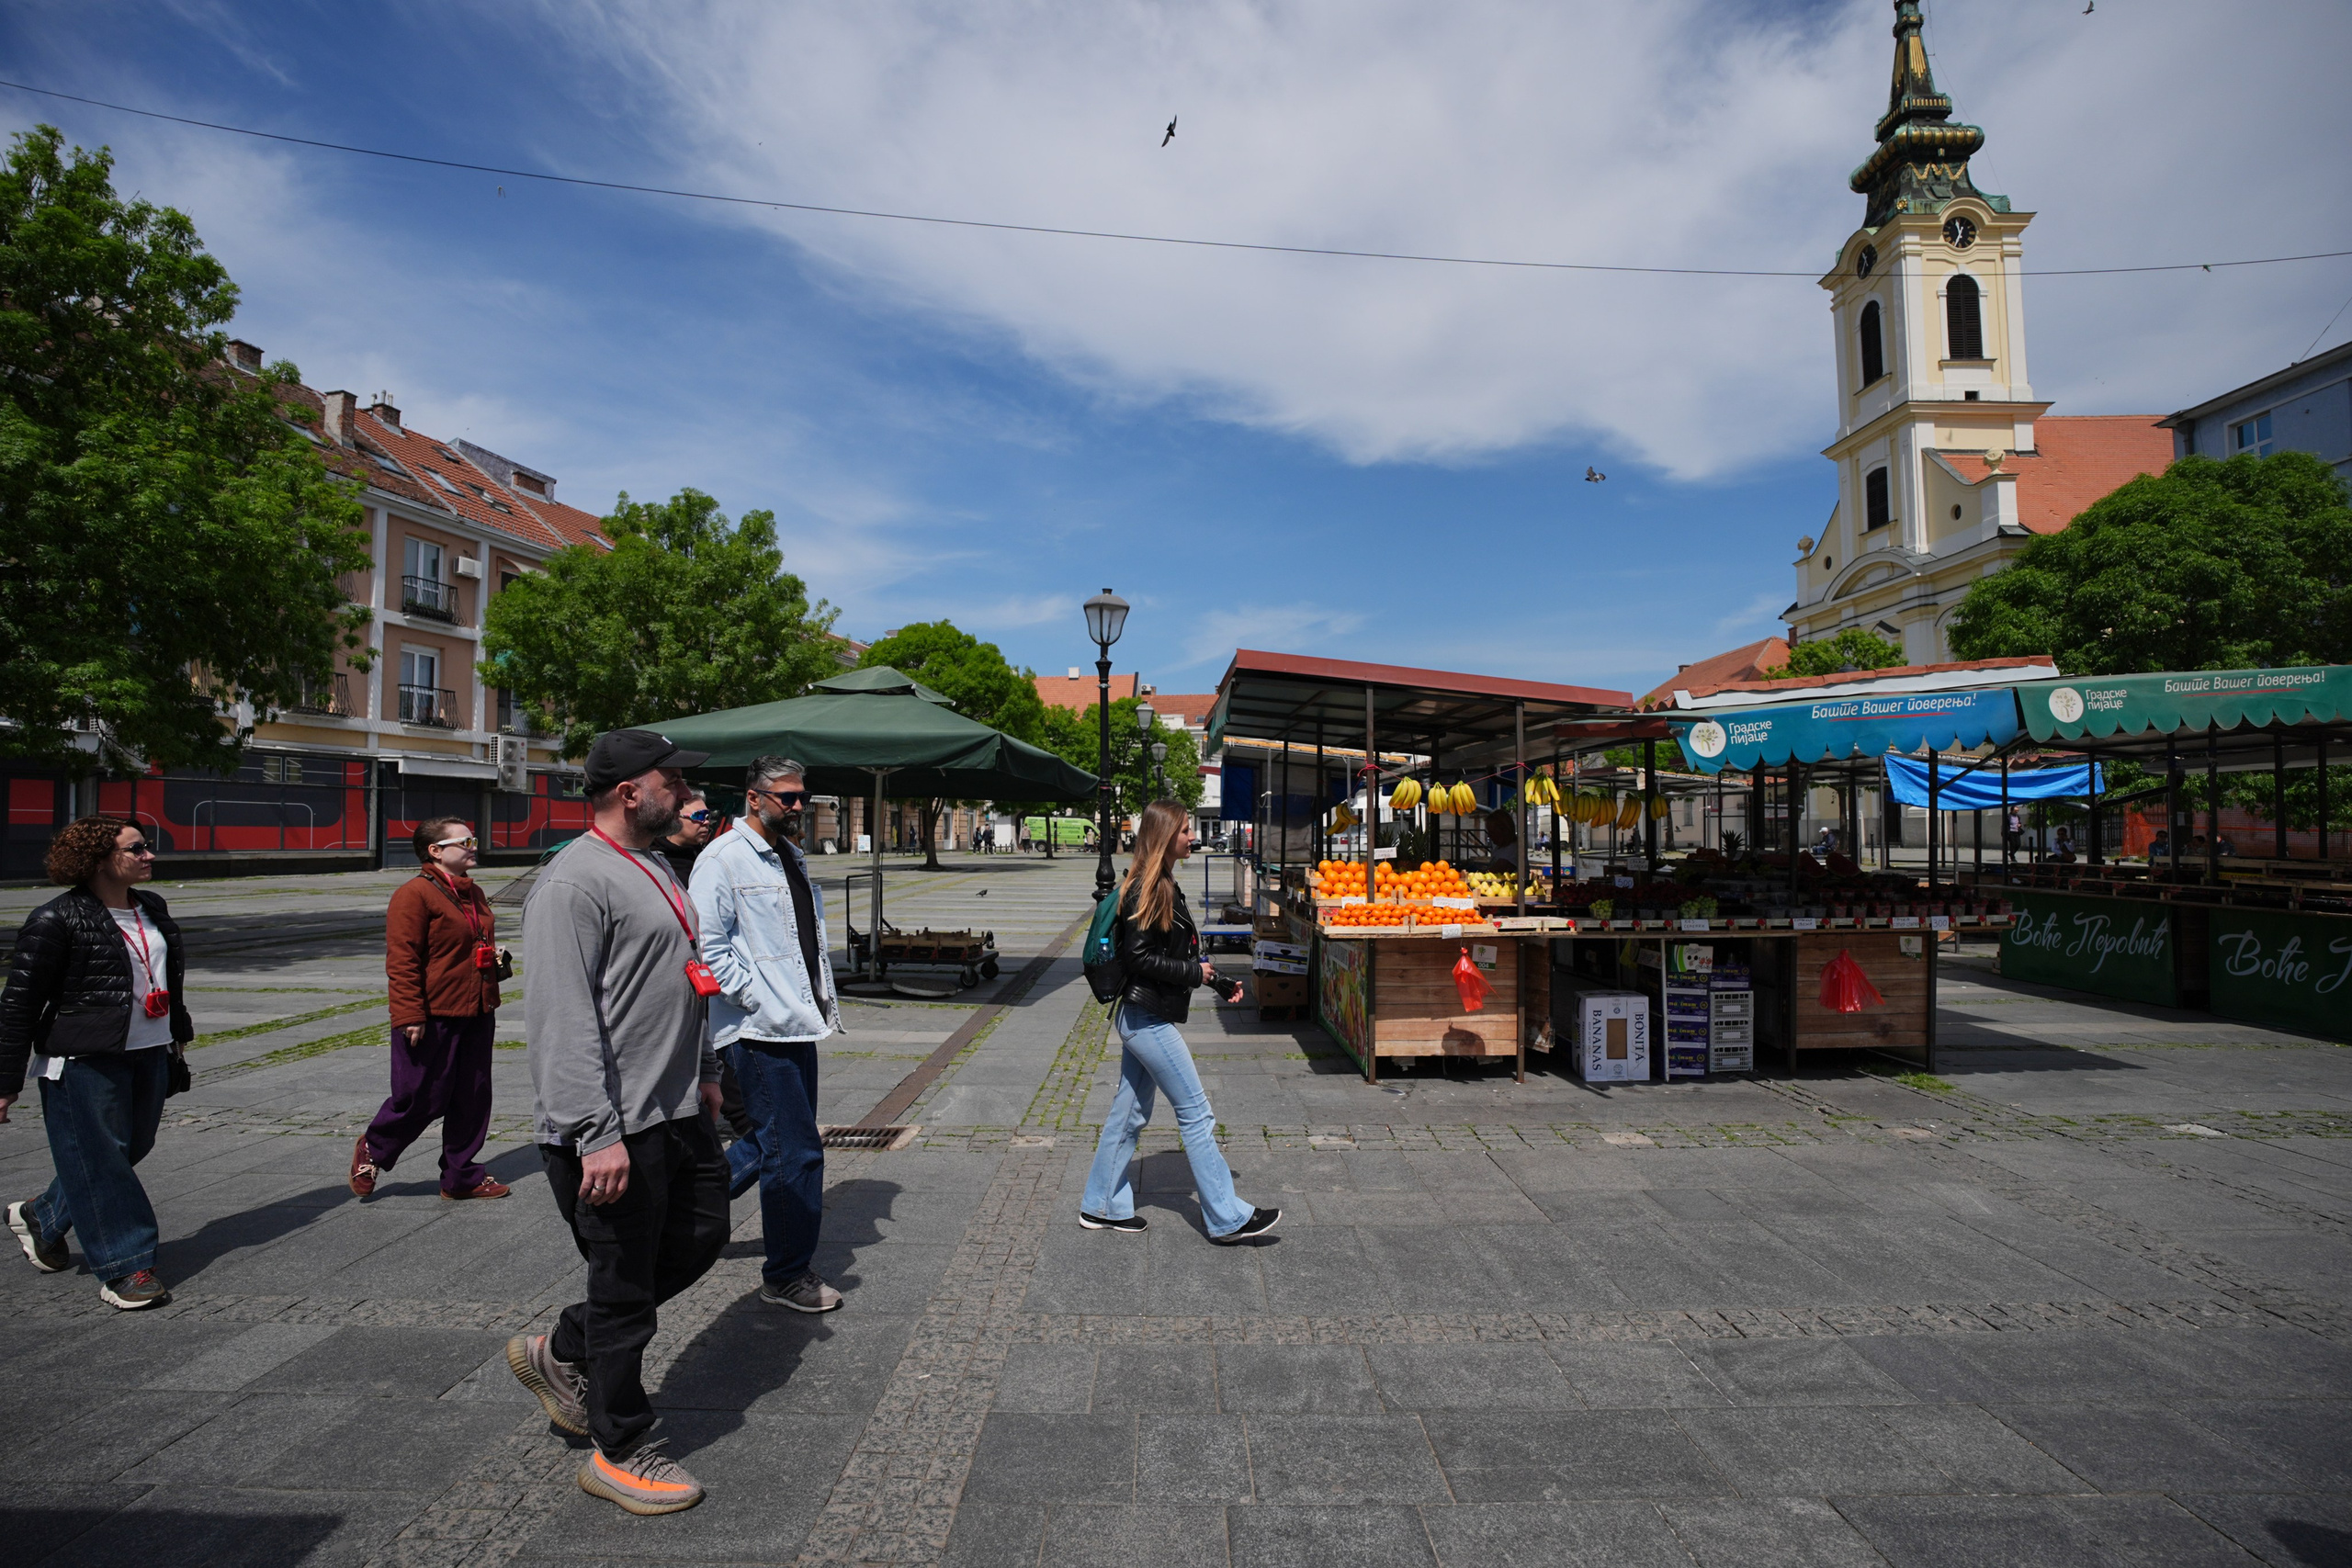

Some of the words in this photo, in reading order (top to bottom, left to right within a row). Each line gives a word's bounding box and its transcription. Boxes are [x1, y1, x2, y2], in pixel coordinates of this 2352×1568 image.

[2165, 678, 2210, 693] Баште
[2213, 675, 2253, 690] Вашег
[2257, 670, 2325, 688] поверења!
[2086, 688, 2128, 702] Градске
[1811, 702, 1859, 719] Баште
[1861, 700, 1905, 716] Вашег
[1907, 692, 1977, 713] поверења!
[2087, 698, 2124, 711] пијаце
[1728, 720, 1772, 735] Градске
[1730, 731, 1769, 745] пијаце
[1933, 919, 1948, 928] 300
[1443, 928, 1459, 937] 350
[2218, 929, 2310, 985] Воће
[1592, 1010, 1602, 1071] BANANAS
